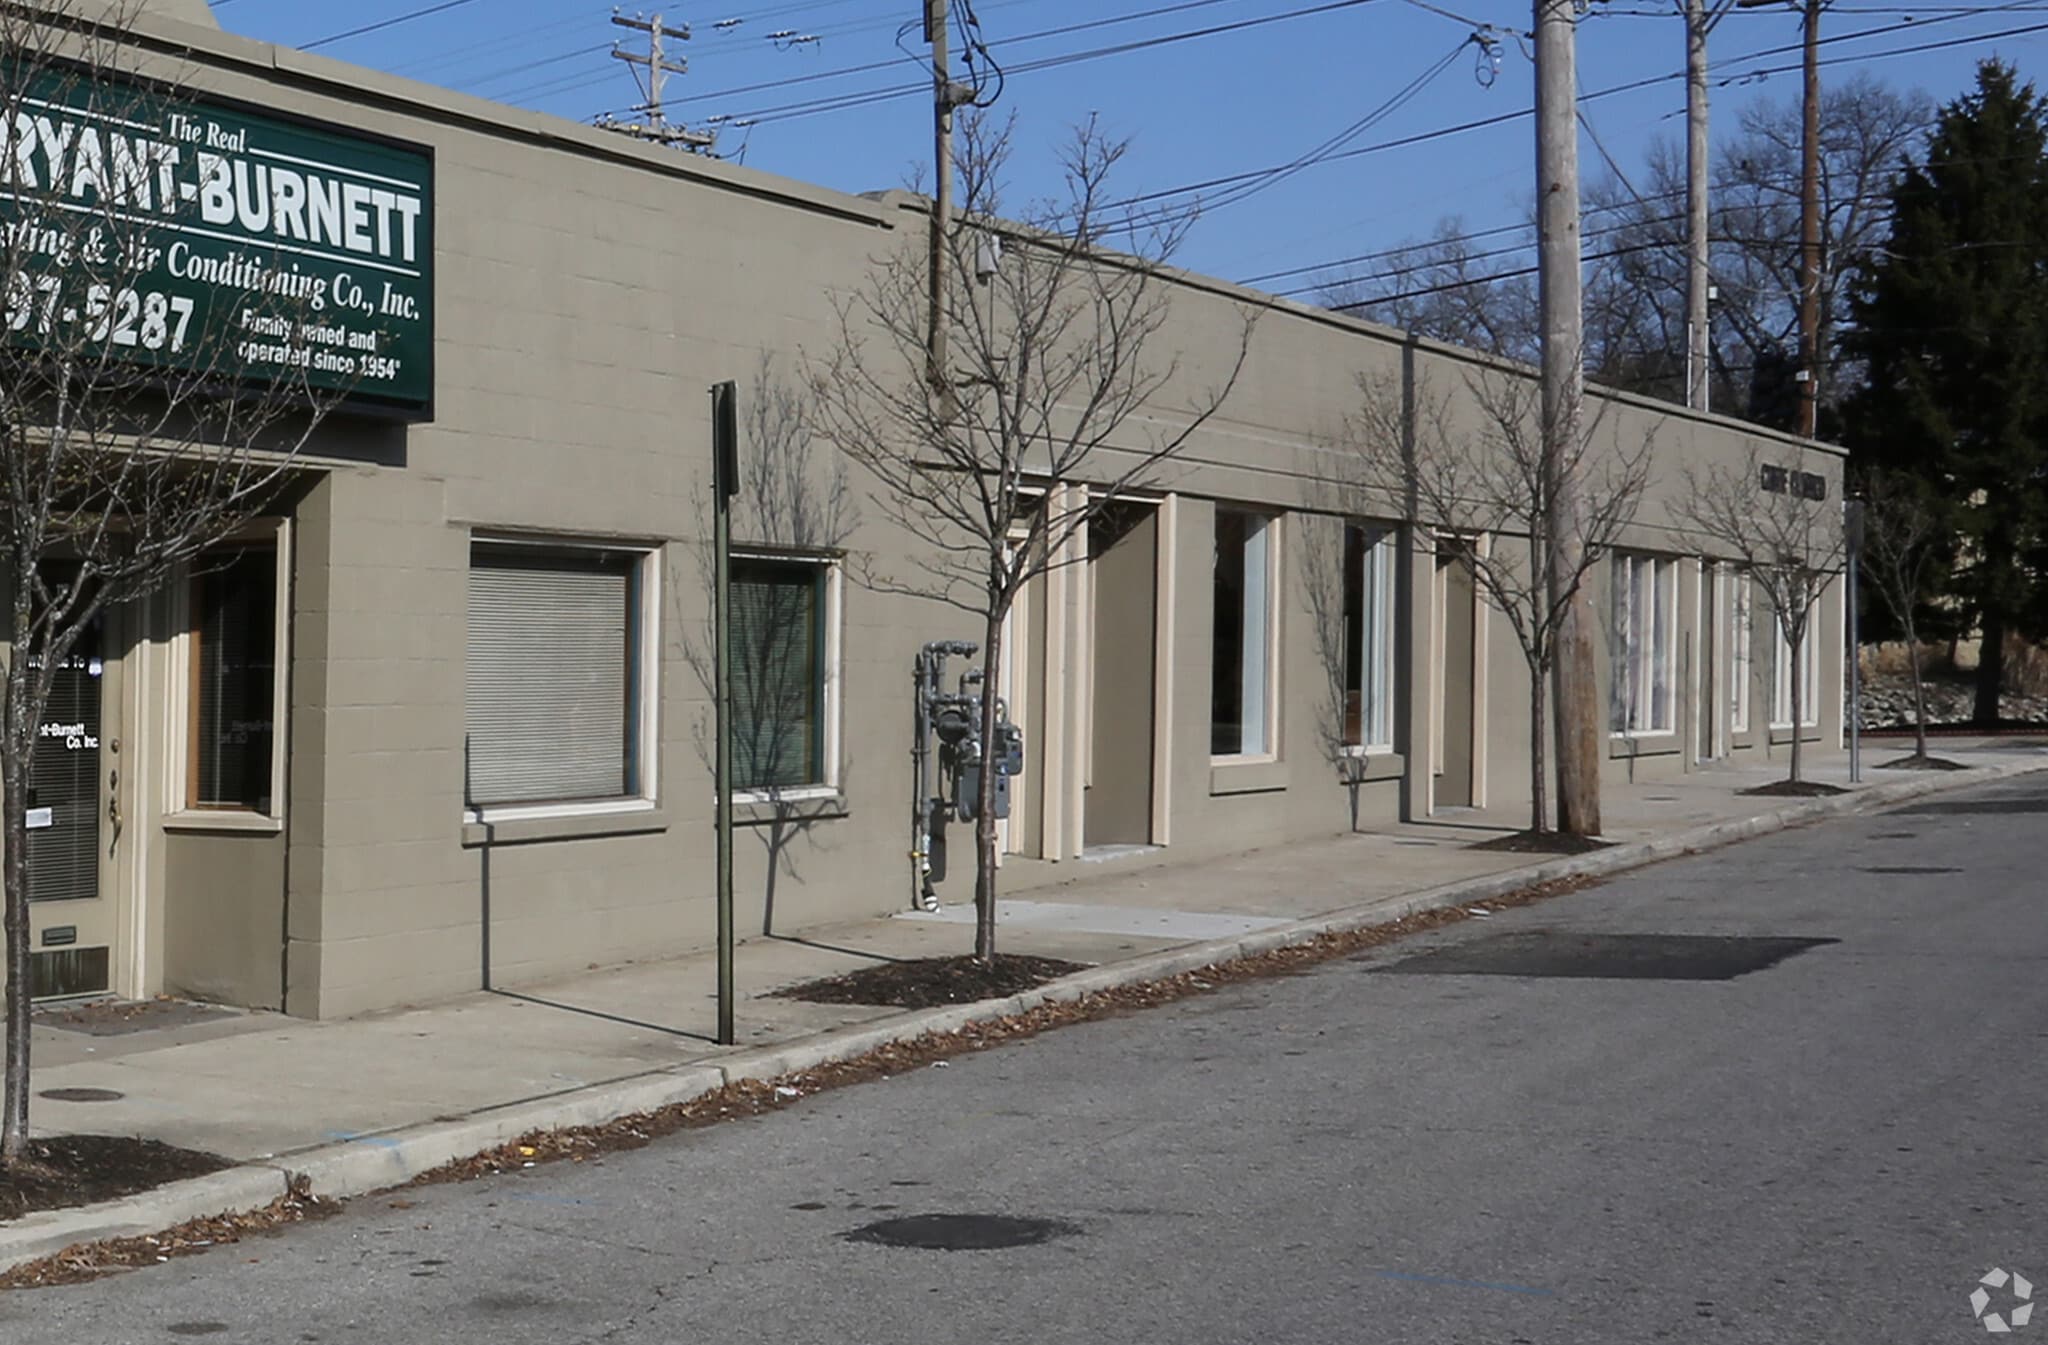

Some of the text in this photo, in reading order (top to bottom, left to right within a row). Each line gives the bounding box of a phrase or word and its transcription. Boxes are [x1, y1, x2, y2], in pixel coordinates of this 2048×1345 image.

[168, 113, 245, 153] The Real
[168, 241, 327, 311] Conditioning
[332, 273, 374, 317] Co.,
[380, 282, 420, 320] Inc.
[297, 324, 345, 346] wned
[349, 330, 376, 351] and
